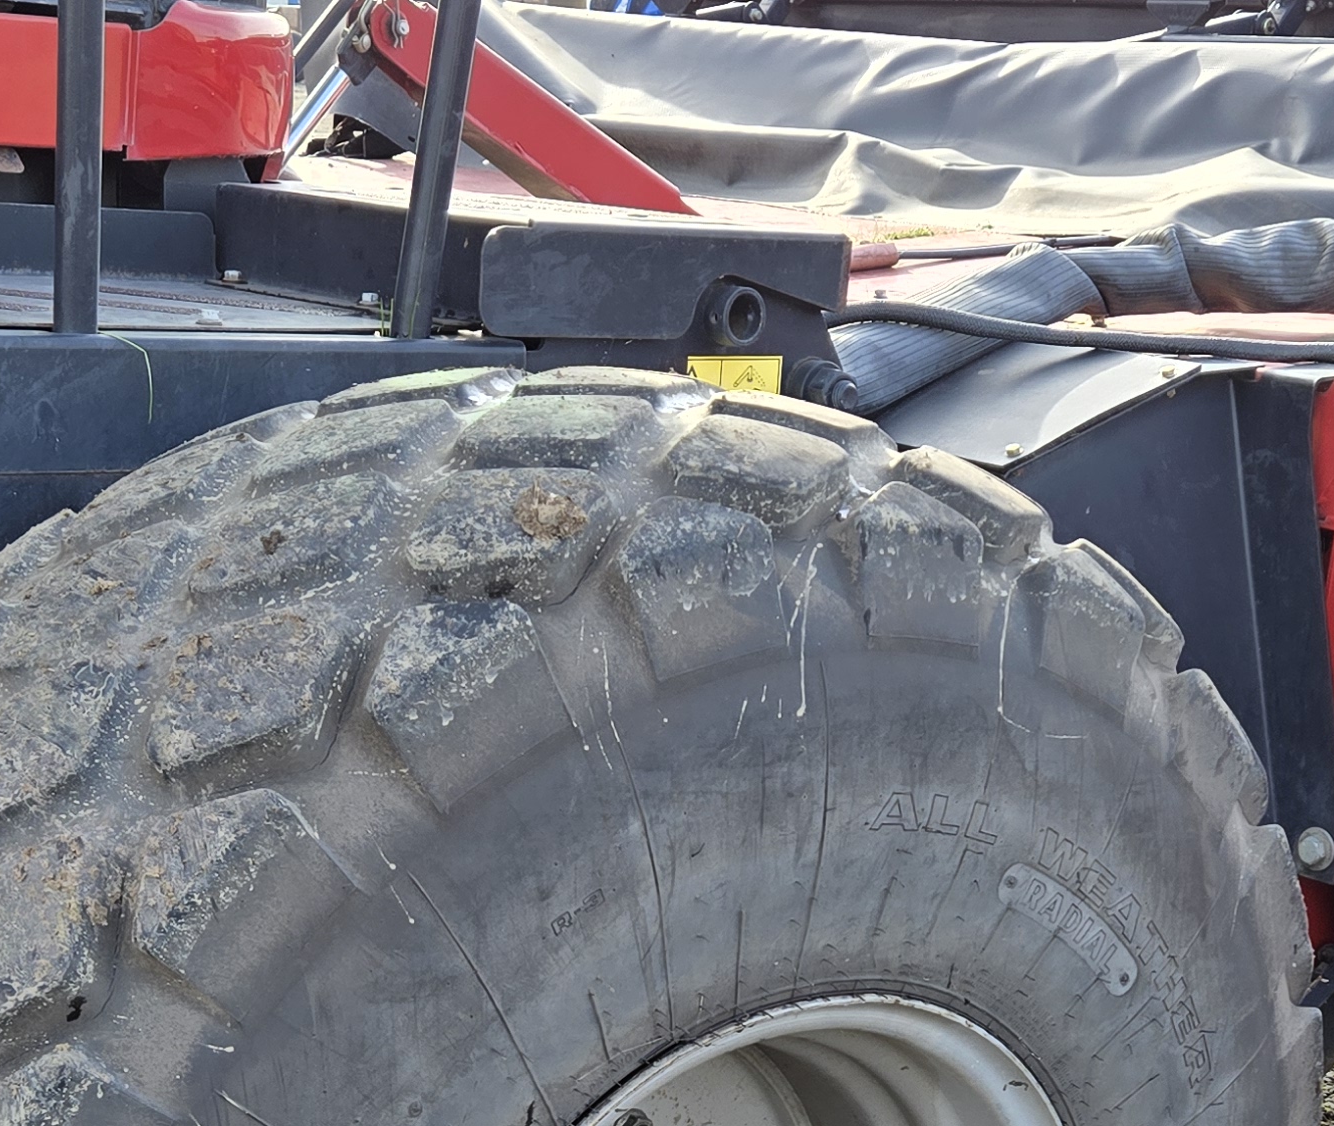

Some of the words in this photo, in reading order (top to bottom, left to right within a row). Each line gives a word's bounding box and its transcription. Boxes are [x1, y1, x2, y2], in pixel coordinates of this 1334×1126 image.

[550, 888, 606, 937] R-3
[868, 791, 999, 845] ALL
[1038, 826, 1212, 1089] WEATHER
[1023, 878, 1119, 976] RADIAL
